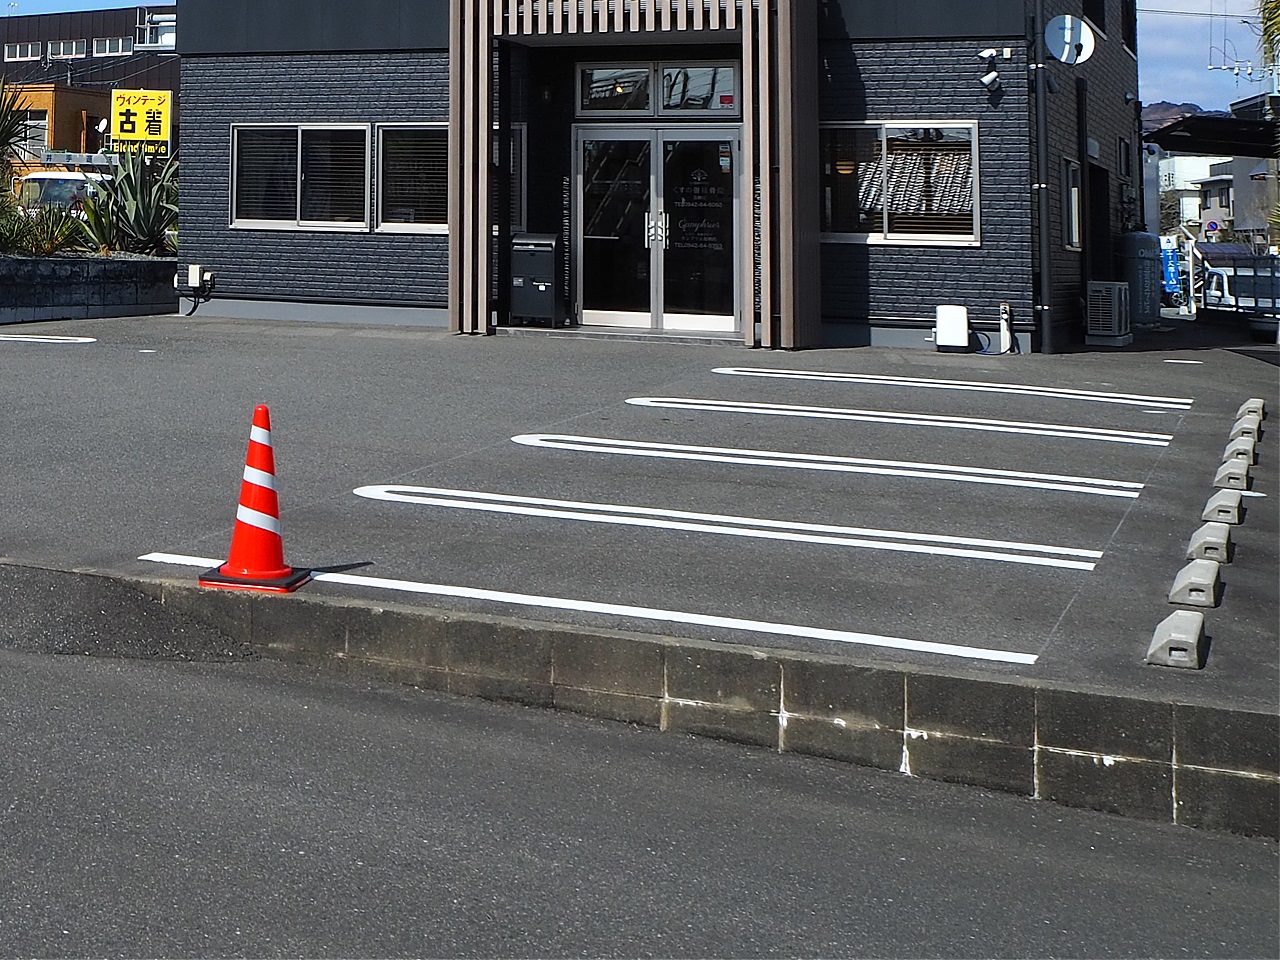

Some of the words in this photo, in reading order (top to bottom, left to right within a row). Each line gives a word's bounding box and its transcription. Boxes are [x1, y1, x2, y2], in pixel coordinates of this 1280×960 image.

[116, 93, 166, 107] ヴィンテージ
[118, 108, 163, 136] 古着
